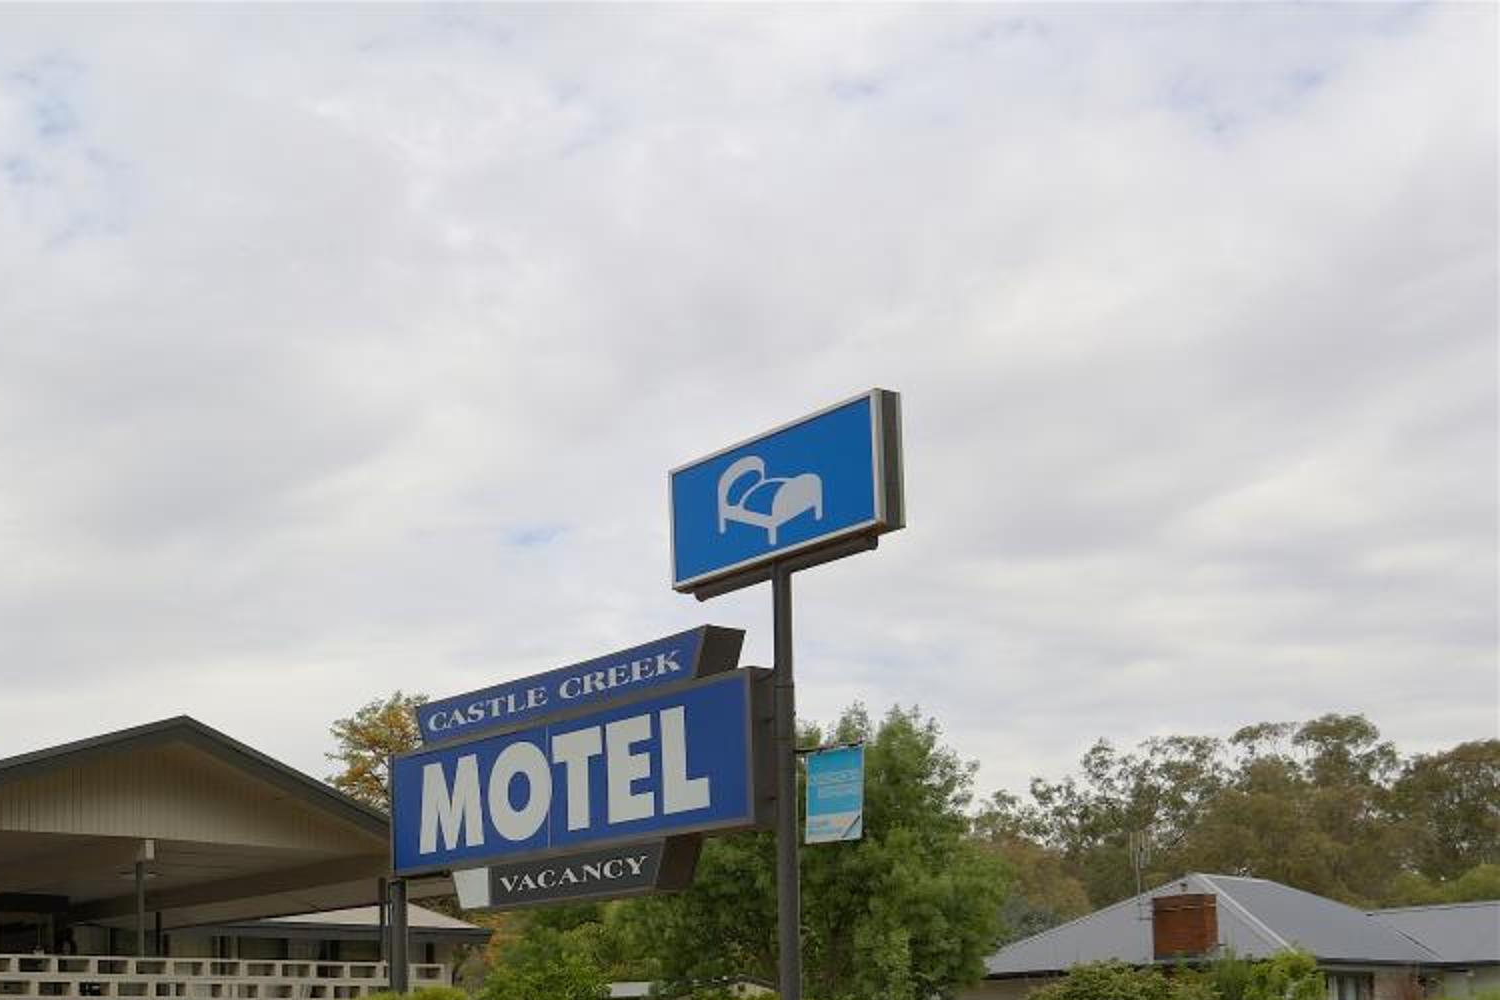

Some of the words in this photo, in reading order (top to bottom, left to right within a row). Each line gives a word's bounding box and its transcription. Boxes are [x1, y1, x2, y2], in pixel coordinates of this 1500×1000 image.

[428, 686, 549, 732] CASTLE
[559, 650, 682, 700] CREEK
[419, 705, 711, 855] MOTEL
[500, 856, 648, 892] VACANCY
